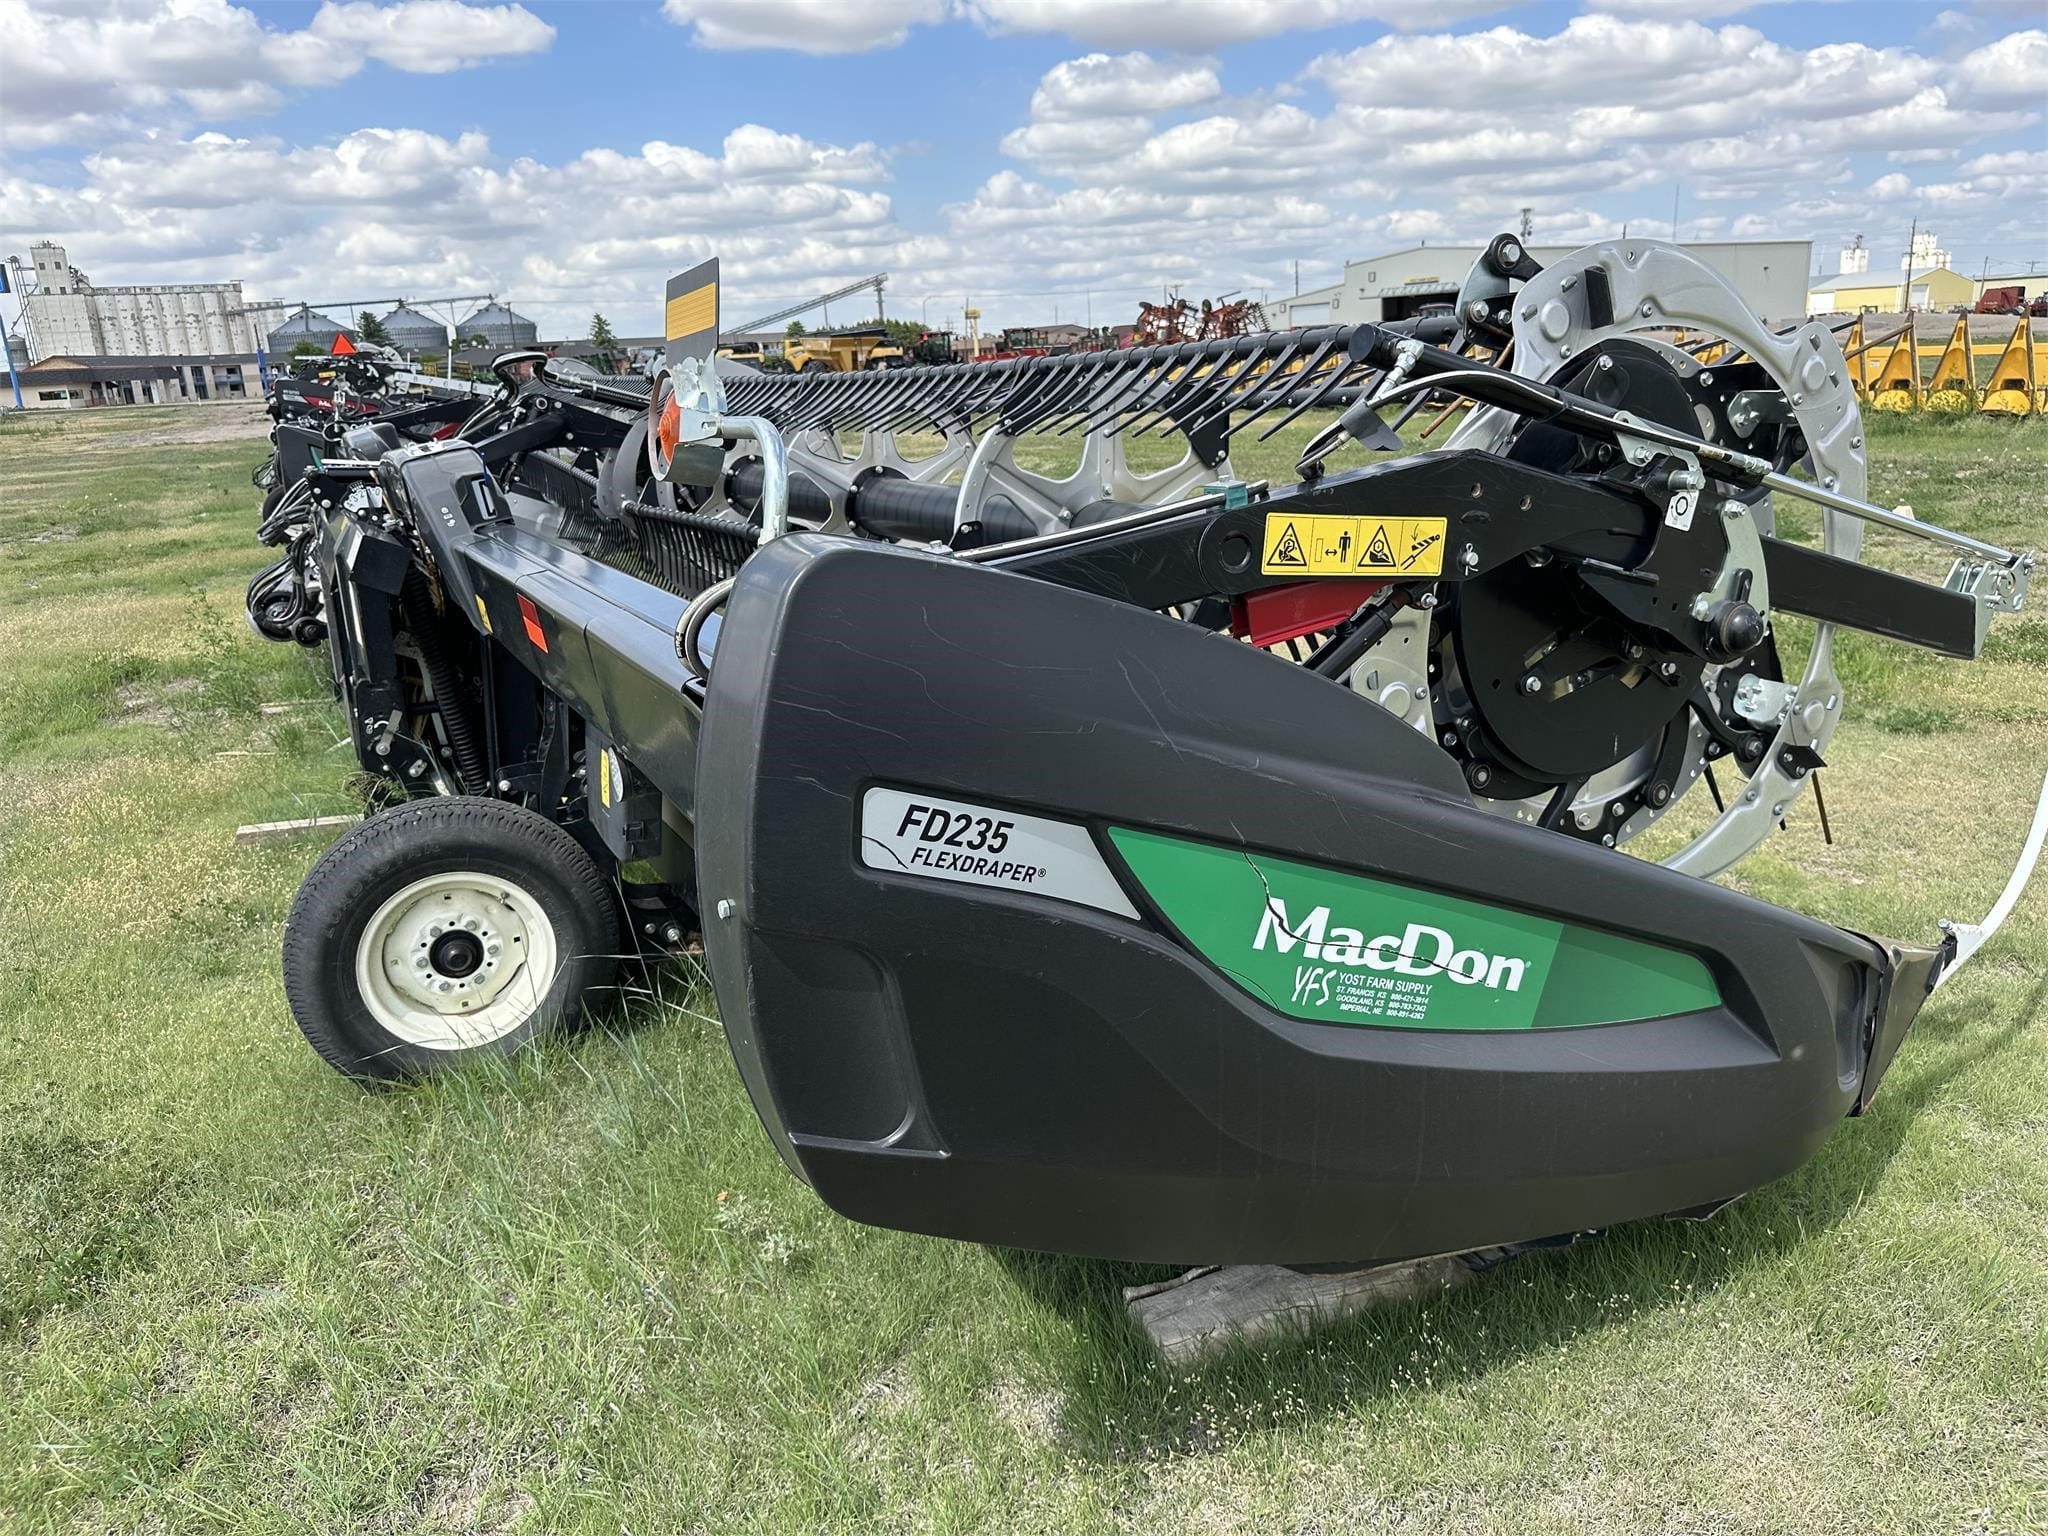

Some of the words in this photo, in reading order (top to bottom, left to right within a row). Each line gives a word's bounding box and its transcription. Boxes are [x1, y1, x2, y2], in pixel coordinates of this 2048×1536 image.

[897, 804, 1015, 855] FD235
[1252, 896, 1526, 992] MacDon
[1291, 965, 1337, 1007] YFS
[1335, 985, 1346, 993] ST.
[1346, 987, 1376, 997] FRANCIS
[1377, 991, 1387, 999] KS
[1339, 972, 1366, 985] YOST
[1366, 976, 1395, 990] FARM
[1395, 980, 1433, 995] SUPPLY
[1335, 994, 1374, 1006] GOODLAND,
[1375, 999, 1385, 1007] KS
[1339, 1003, 1371, 1014] IMPERIAL,
[1372, 1007, 1383, 1015] NE
